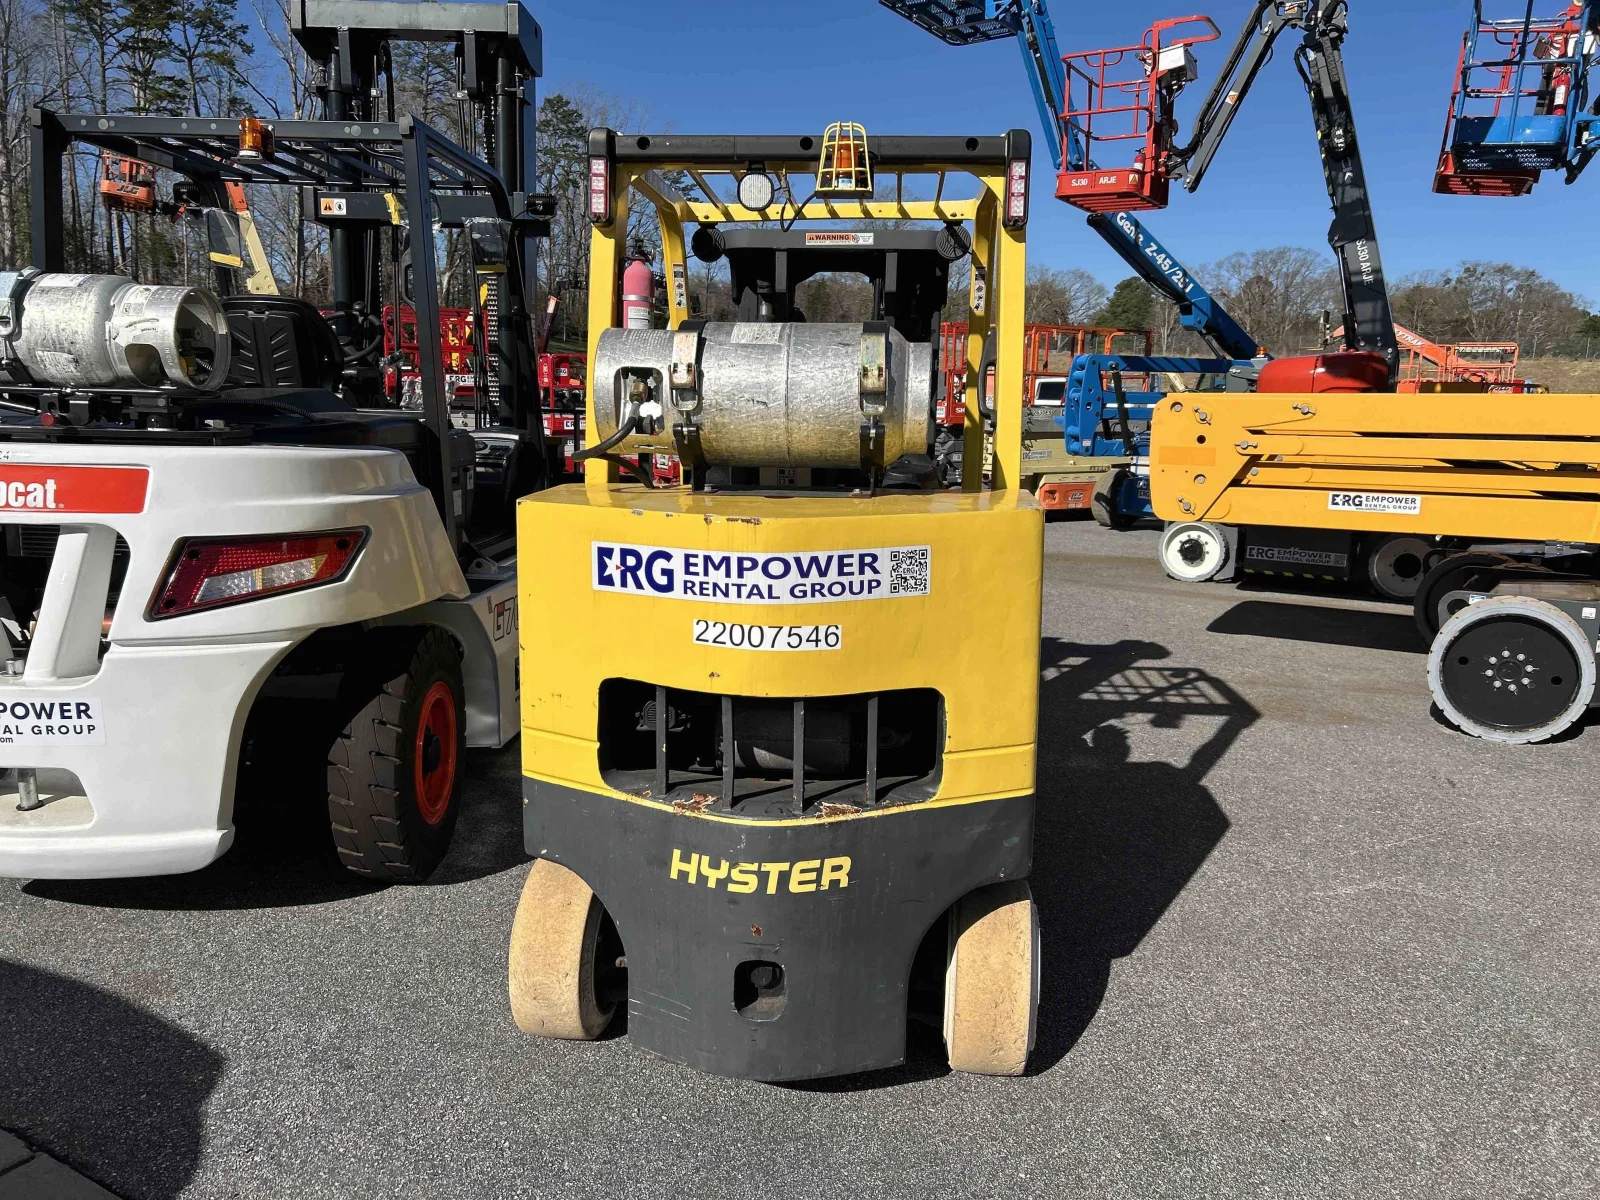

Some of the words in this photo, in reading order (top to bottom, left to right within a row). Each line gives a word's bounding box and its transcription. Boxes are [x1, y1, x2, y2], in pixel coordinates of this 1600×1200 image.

[1071, 178, 1088, 187] SJ30
[1098, 176, 1117, 185] ARJE
[1356, 238, 1369, 261] SJ30
[1360, 262, 1374, 286] ARJE
[1331, 493, 1363, 507] ERG
[1365, 495, 1417, 505] EMPOWER
[1248, 547, 1275, 559] ERG
[1276, 549, 1332, 560] EMPOWER
[597, 546, 675, 593] ERG
[683, 552, 882, 580] EMPOWER
[683, 579, 781, 600] RENTAL
[789, 578, 882, 600] GROUP
[695, 619, 840, 649] 22007546
[31, 724, 96, 736] GROUP
[669, 848, 852, 895] HYSTER
